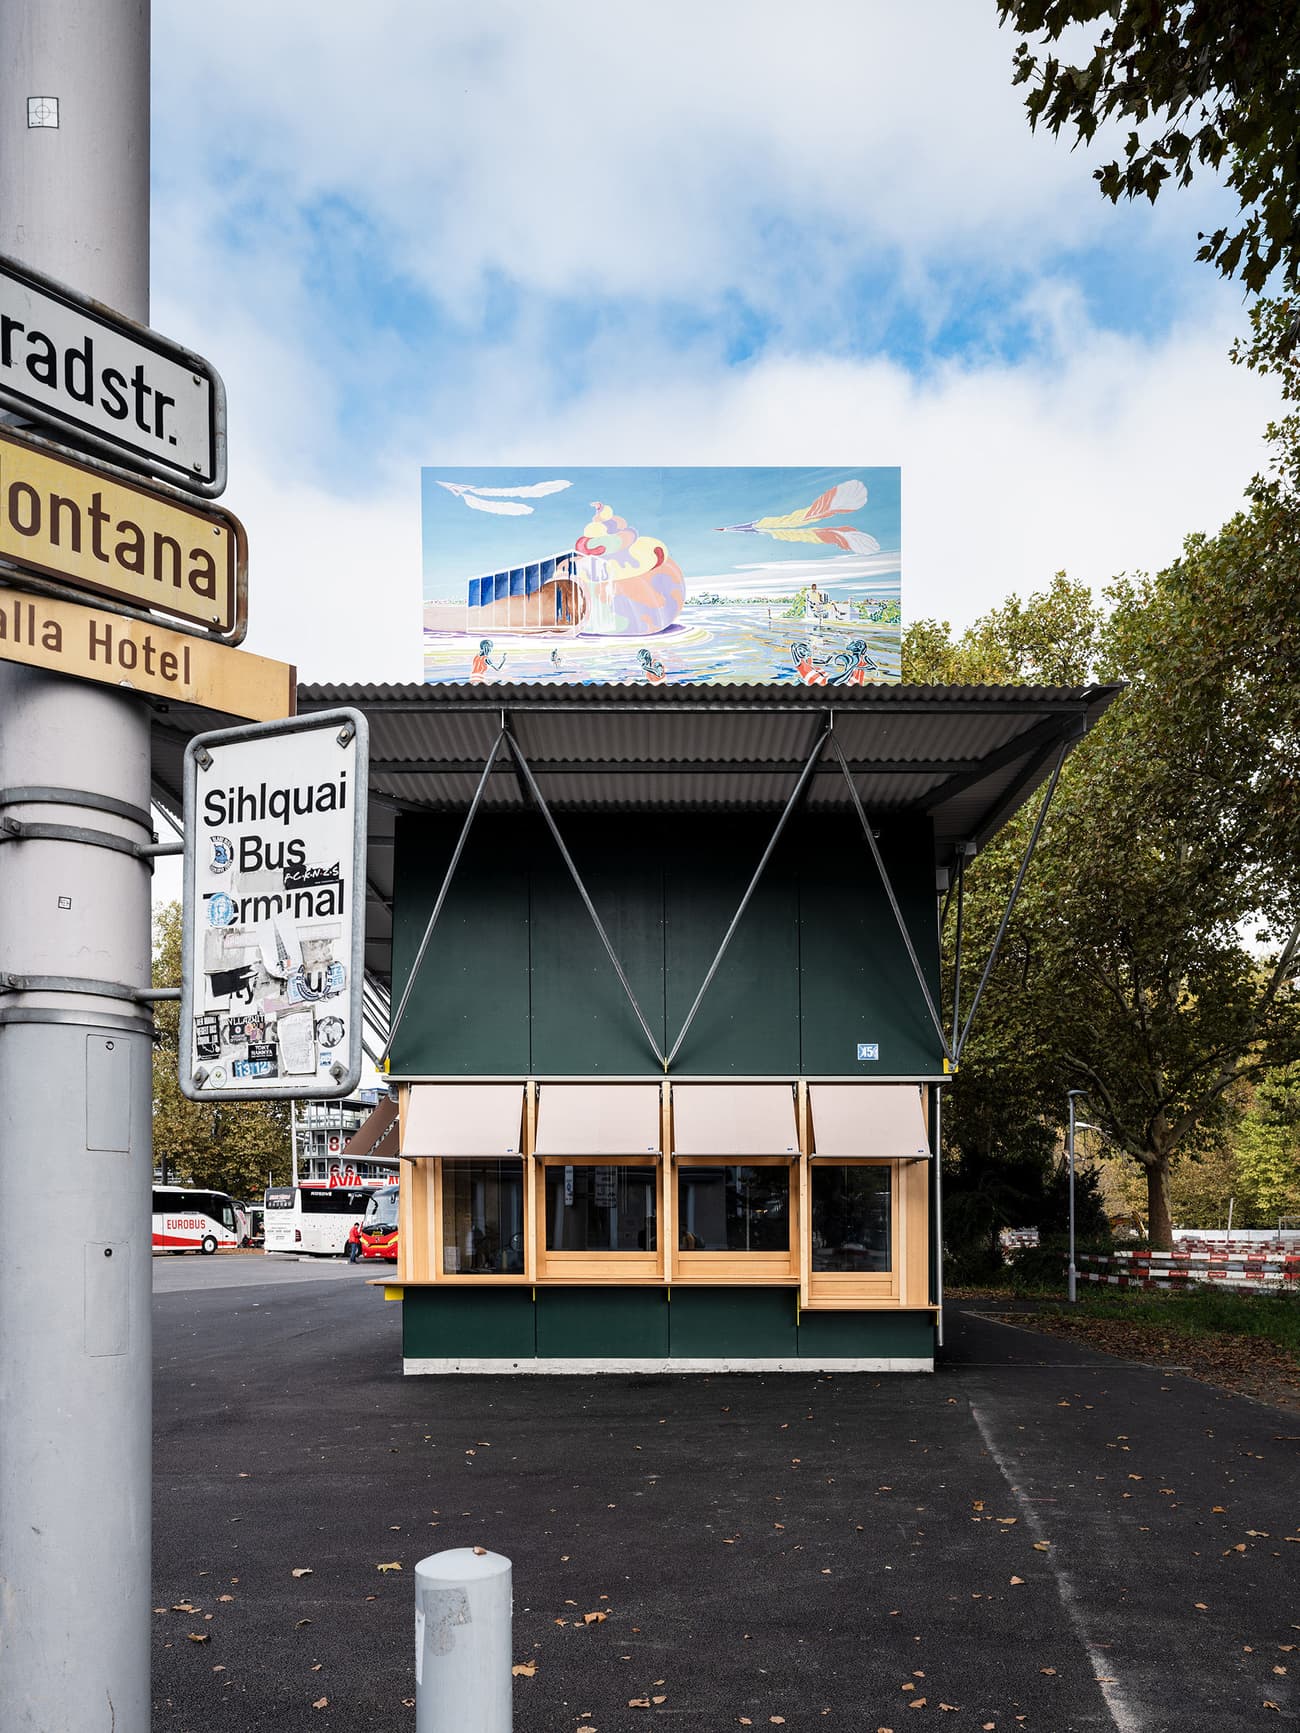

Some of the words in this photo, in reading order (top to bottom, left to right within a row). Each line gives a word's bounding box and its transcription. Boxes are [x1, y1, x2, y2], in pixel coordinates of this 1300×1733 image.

[1, 313, 178, 446] radstr.
[8, 481, 217, 600] ontana
[88, 619, 191, 686] Hotel
[203, 770, 347, 827] Sihlquai
[239, 834, 306, 873] Bus
[329, 1174, 362, 1189] AVIA
[167, 1219, 206, 1230] EUROBUS
